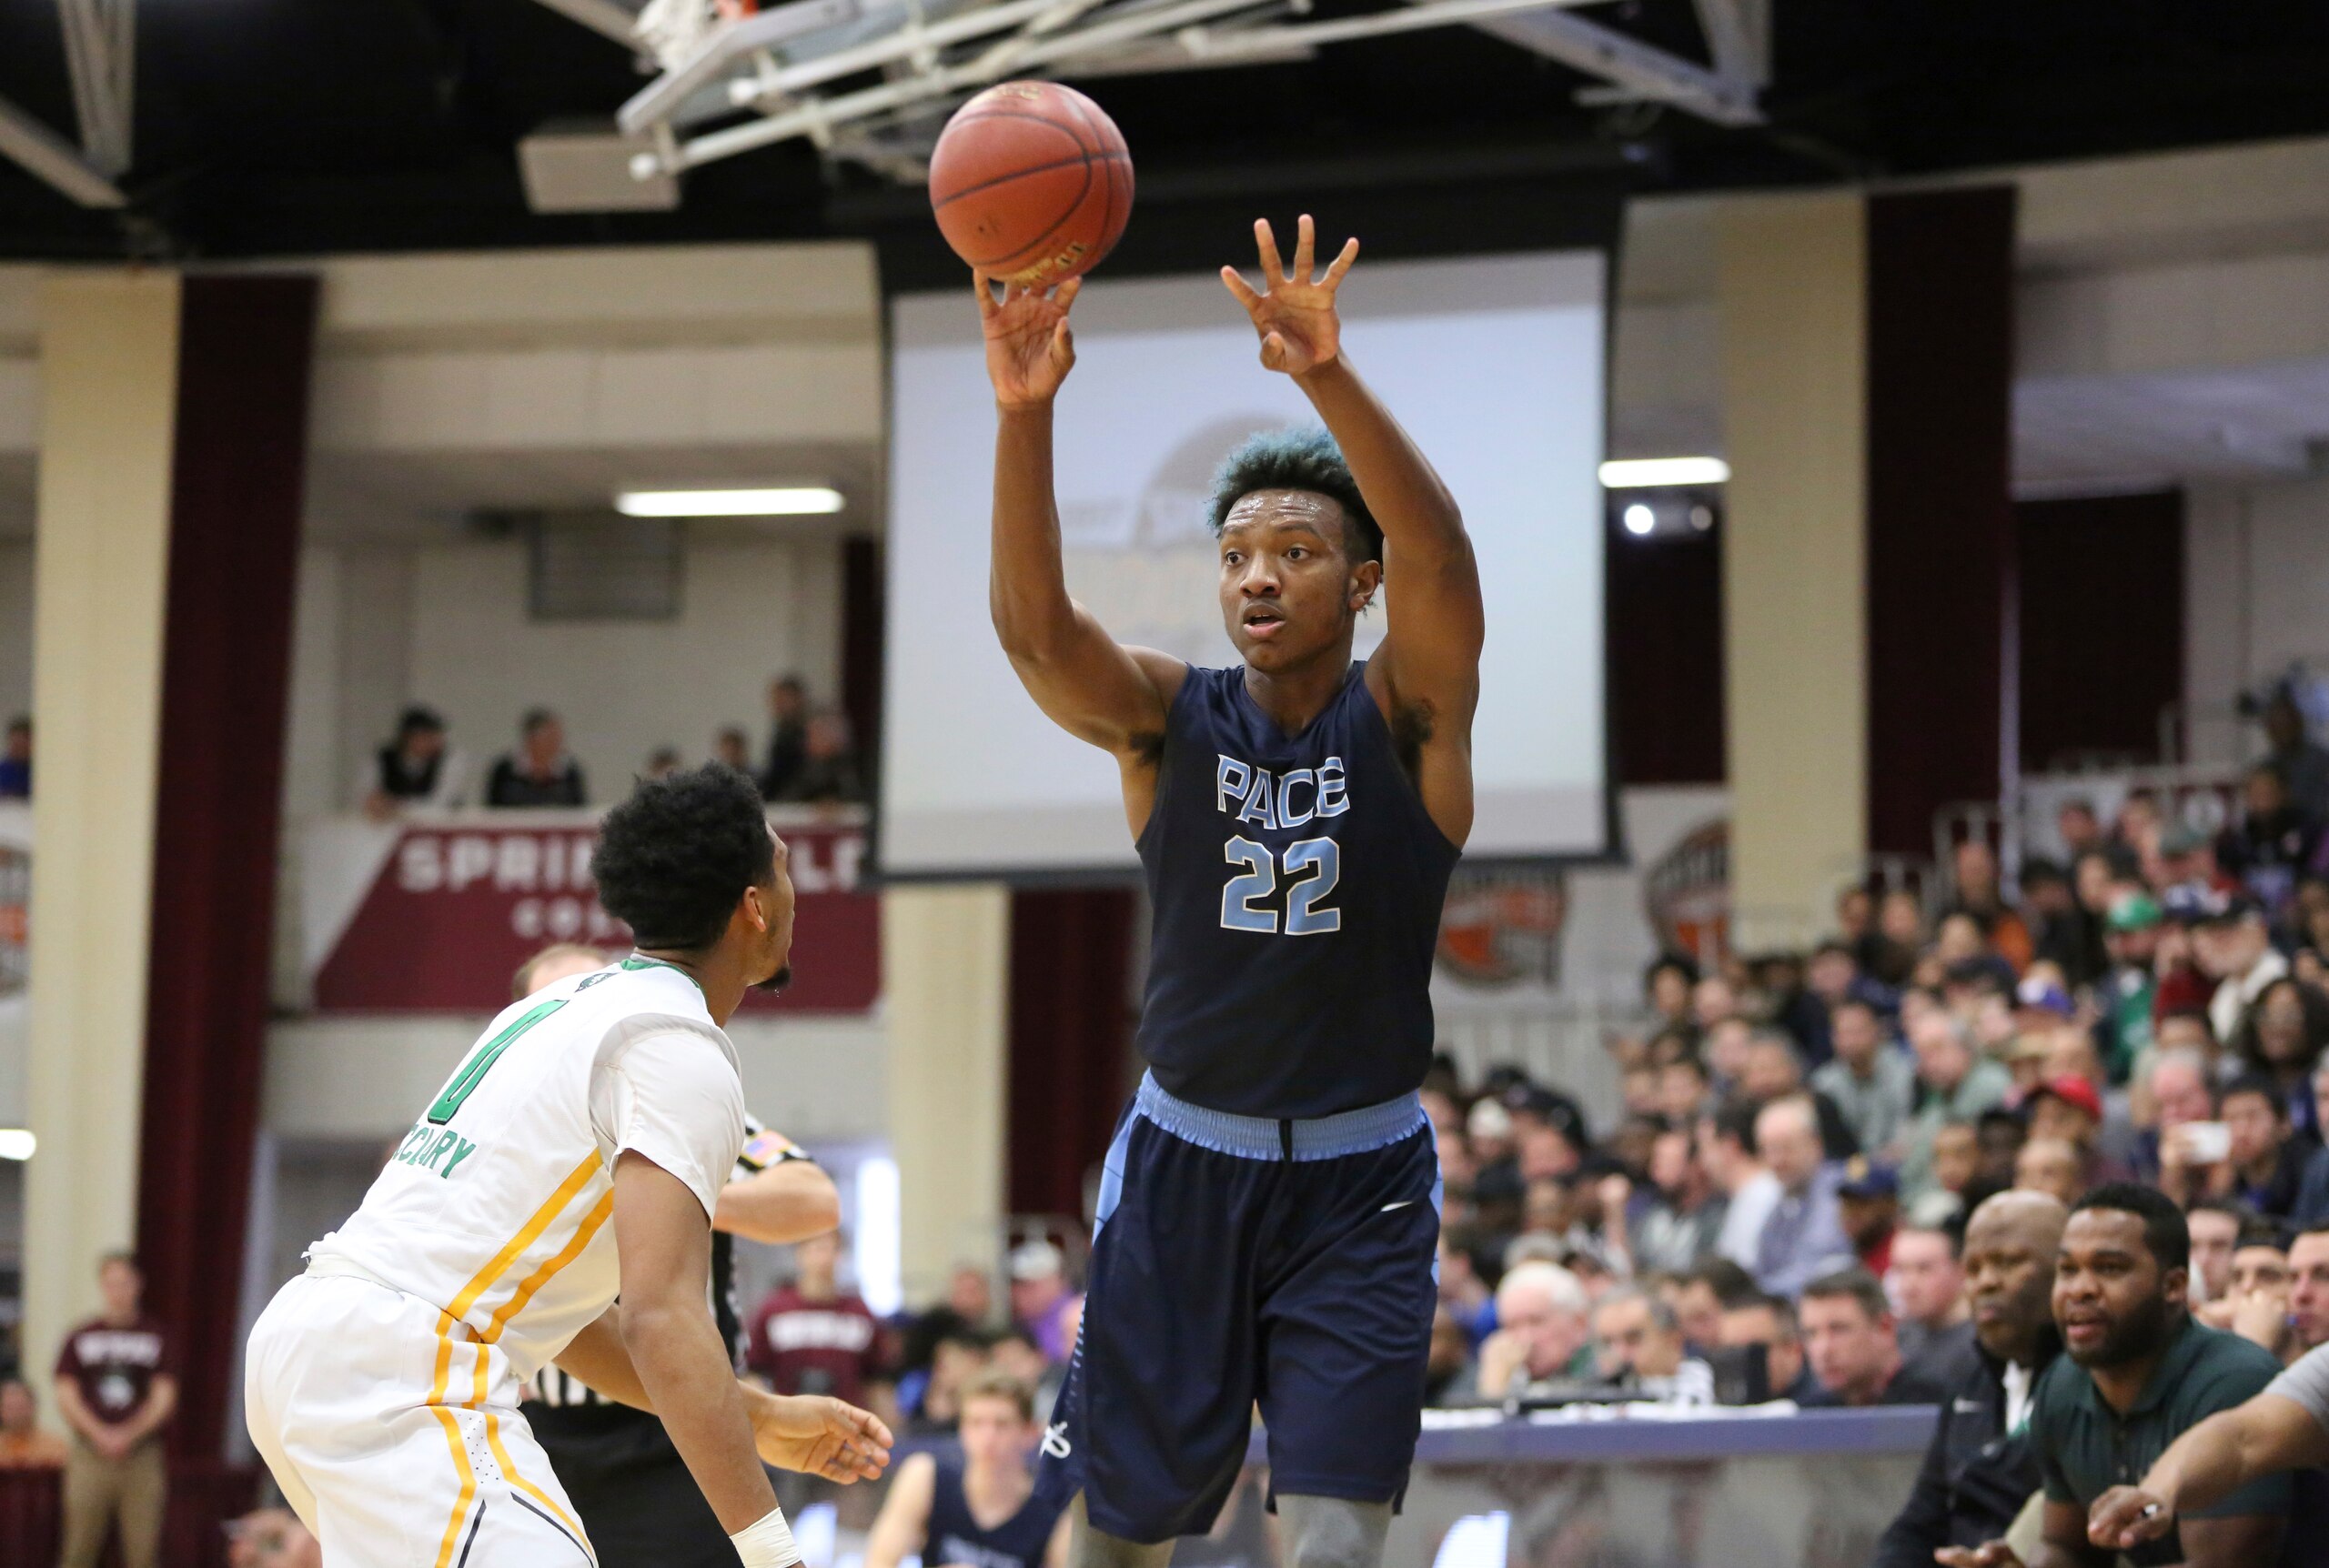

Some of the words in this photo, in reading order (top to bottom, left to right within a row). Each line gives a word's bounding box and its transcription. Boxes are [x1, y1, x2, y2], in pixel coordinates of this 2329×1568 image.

[1217, 754, 1350, 829] PACE
[1220, 834, 1341, 936] 22
[427, 1000, 570, 1125] 0
